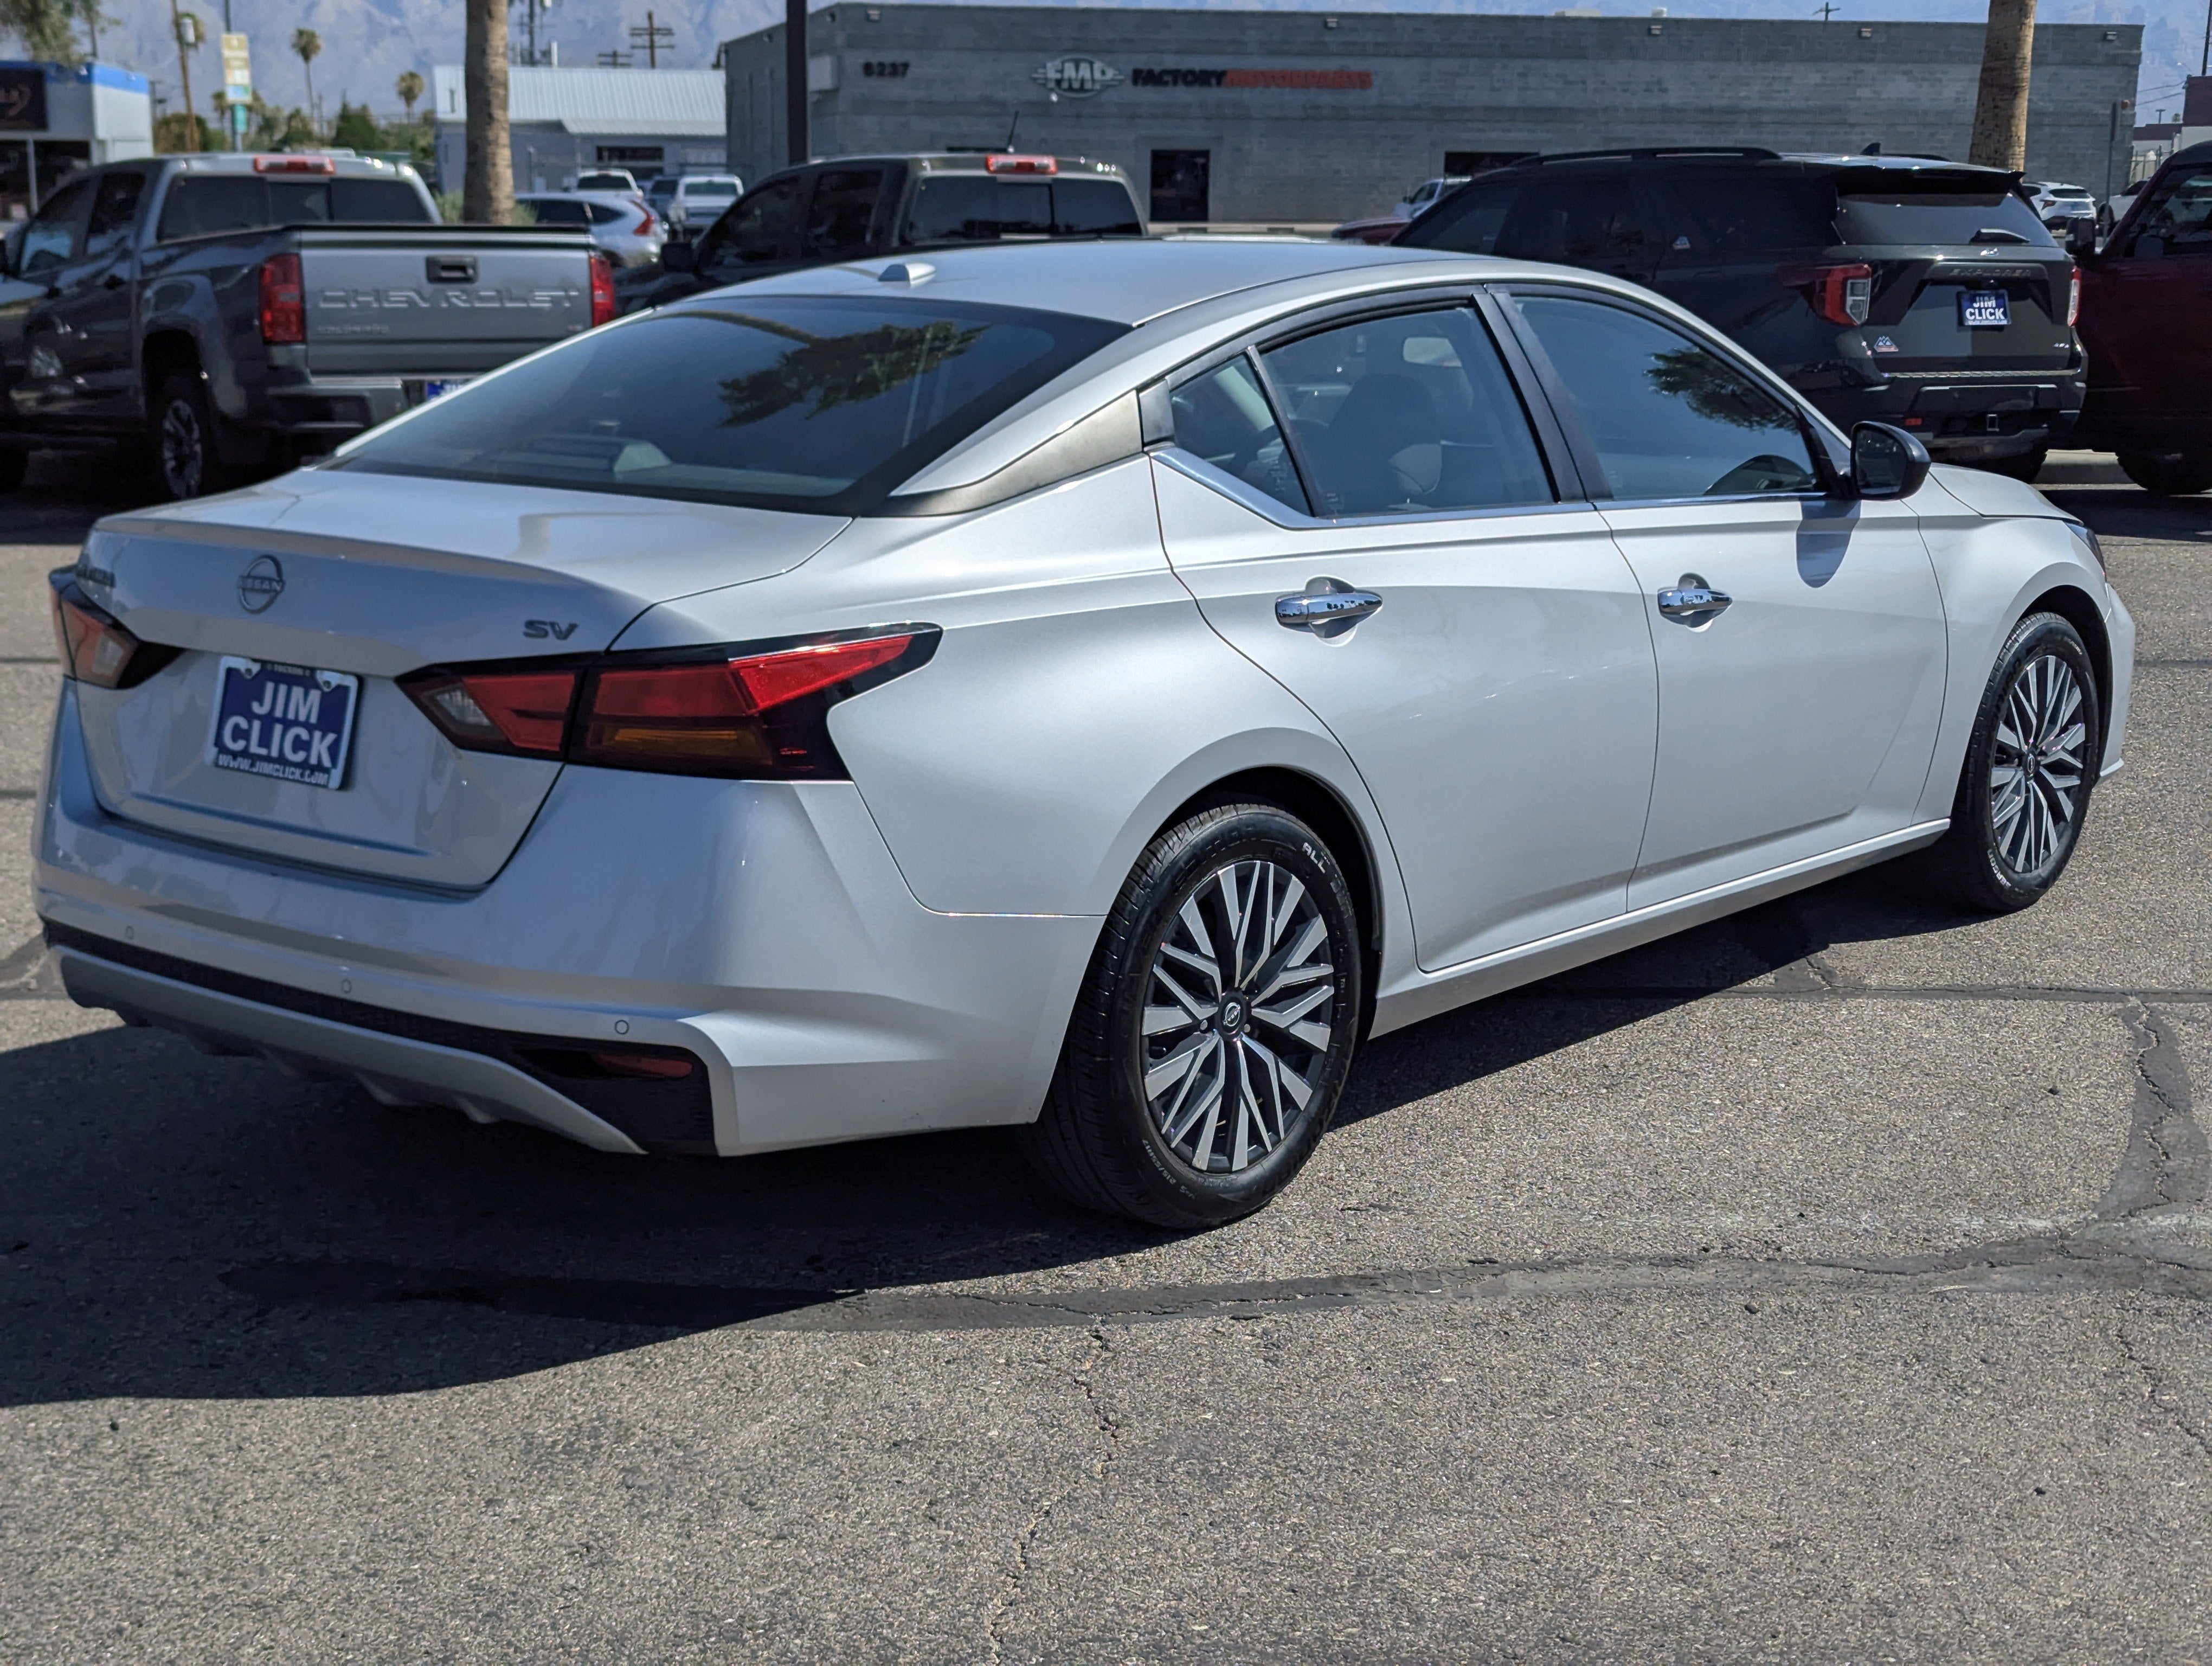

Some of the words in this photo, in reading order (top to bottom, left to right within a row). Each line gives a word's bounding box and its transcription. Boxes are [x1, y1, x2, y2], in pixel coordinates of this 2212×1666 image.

[1045, 61, 1115, 90] FMP
[318, 291, 580, 309] CHEVROLET
[1965, 308, 2005, 319] CLICK
[1972, 297, 1997, 308] JIM
[523, 620, 579, 640] SV
[252, 681, 321, 724] JIM
[222, 715, 338, 768] CLICK
[218, 754, 329, 786] WWW.JIMCLICK.COM
[1302, 842, 1326, 874] ALL
